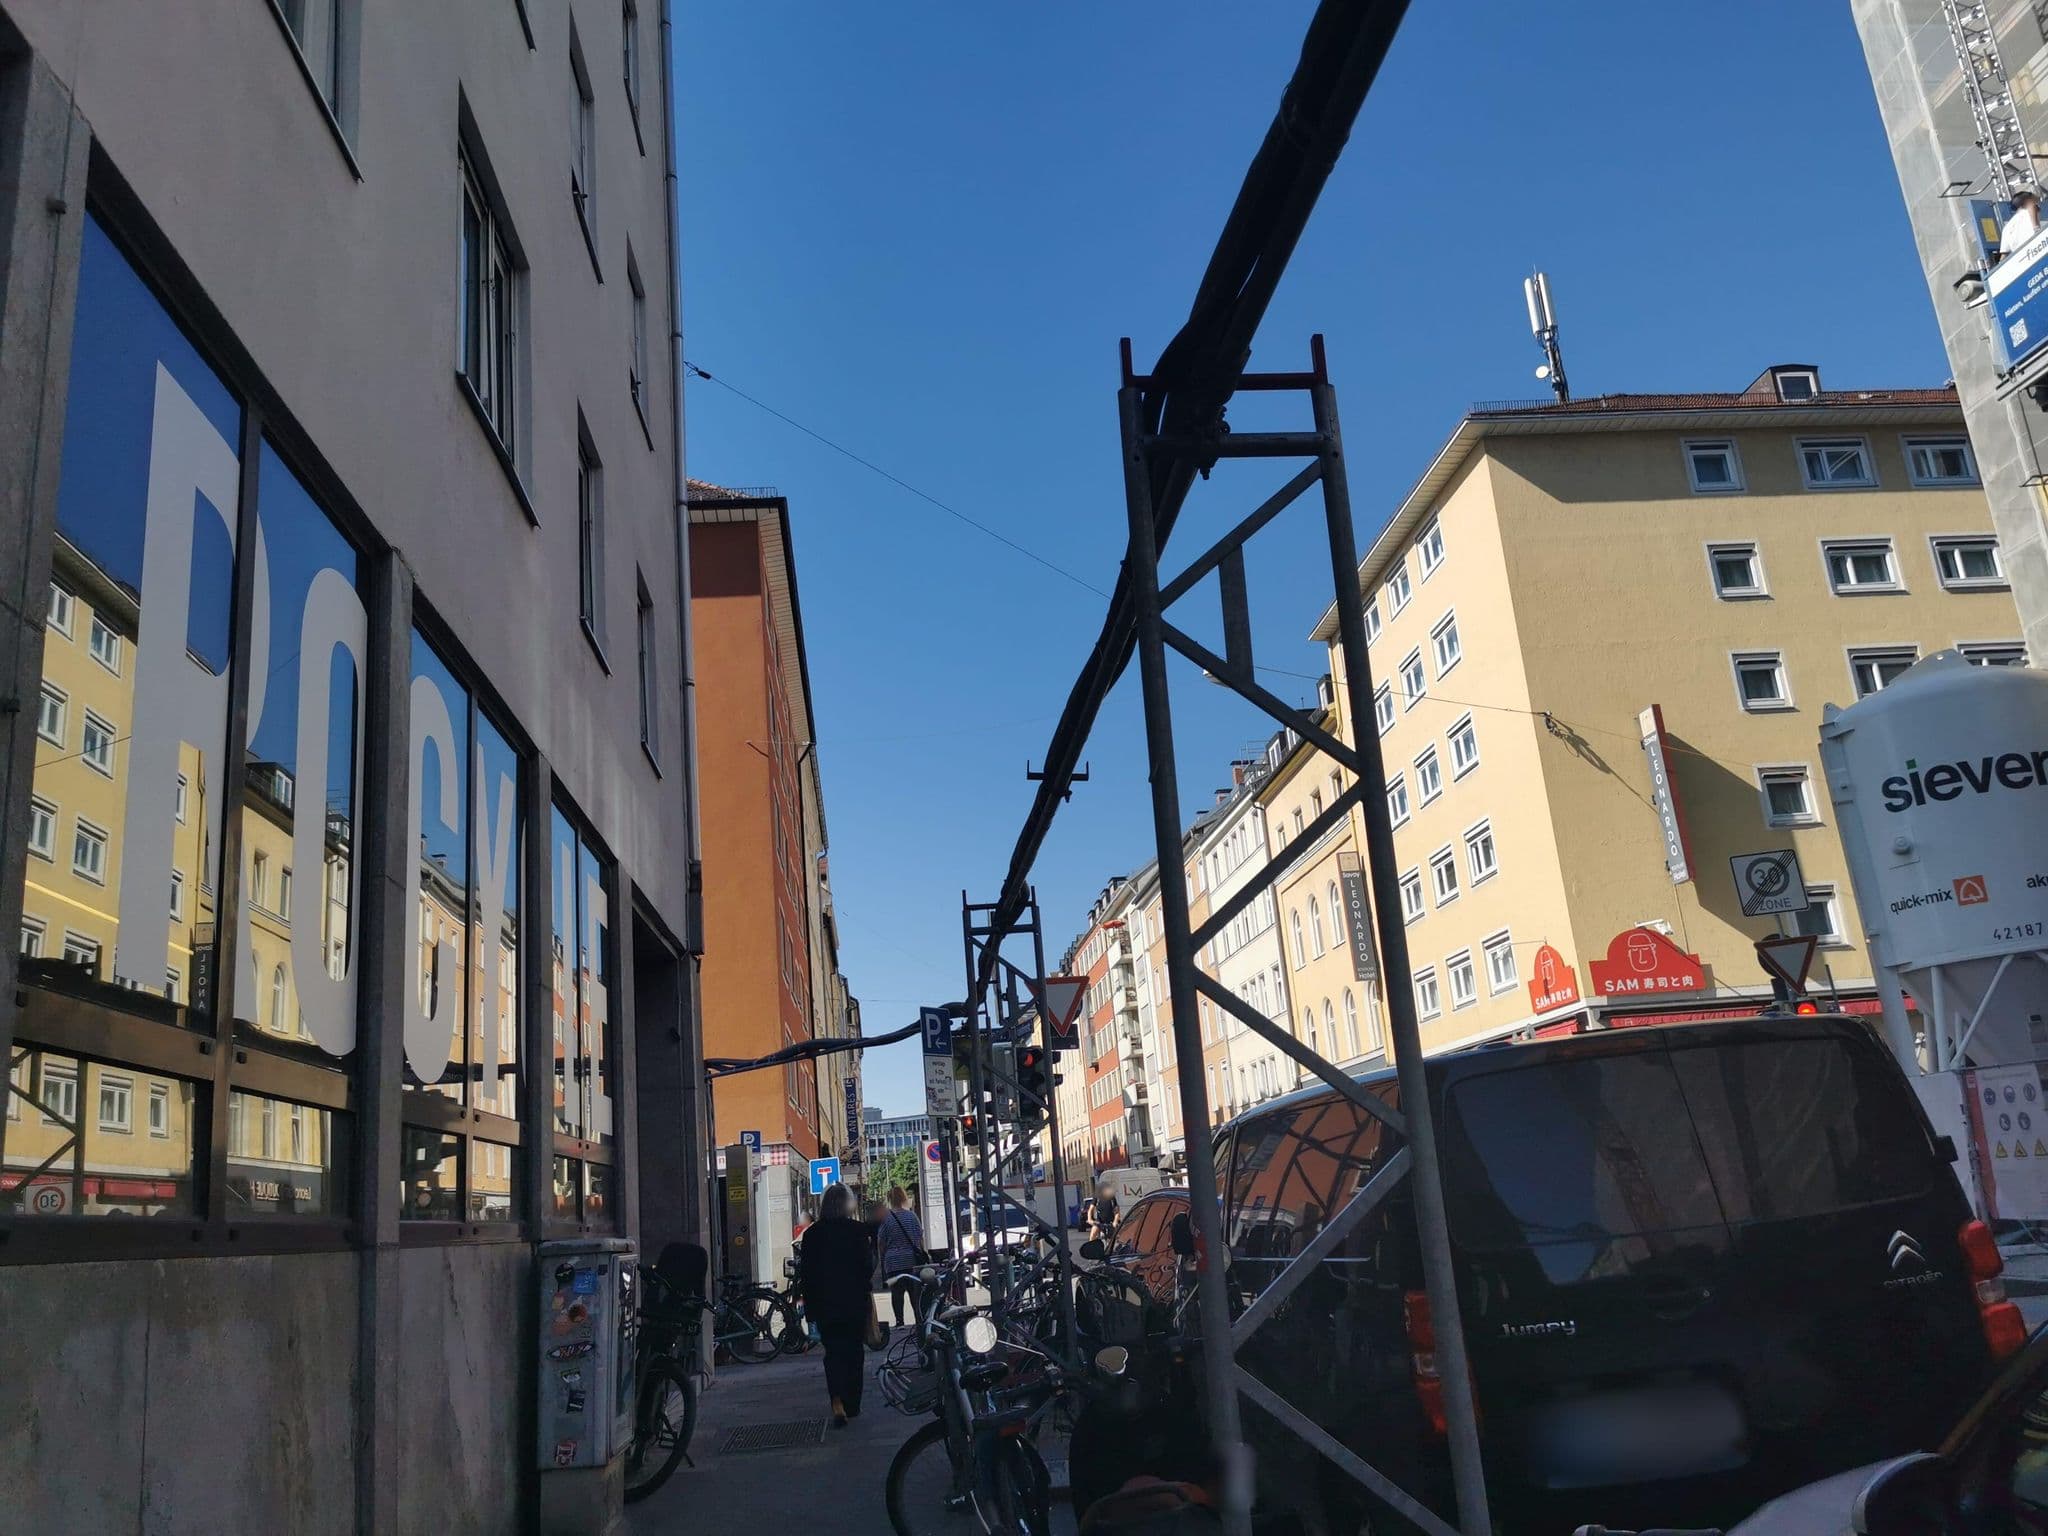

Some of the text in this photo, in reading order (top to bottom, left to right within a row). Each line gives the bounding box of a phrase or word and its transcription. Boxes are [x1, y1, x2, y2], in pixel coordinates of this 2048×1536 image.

[1650, 746, 1678, 857] LEONARDO
[1754, 869, 1781, 889] 30
[2026, 873, 2048, 889] ak
[1760, 897, 1793, 912] ZONE
[1890, 889, 1953, 915] quick-mix
[1350, 880, 1368, 962] LEONARDO
[1993, 922, 2043, 941] 42187
[1605, 977, 1640, 992] SAM
[926, 1013, 941, 1049] P
[847, 1093, 857, 1133] ANTARES
